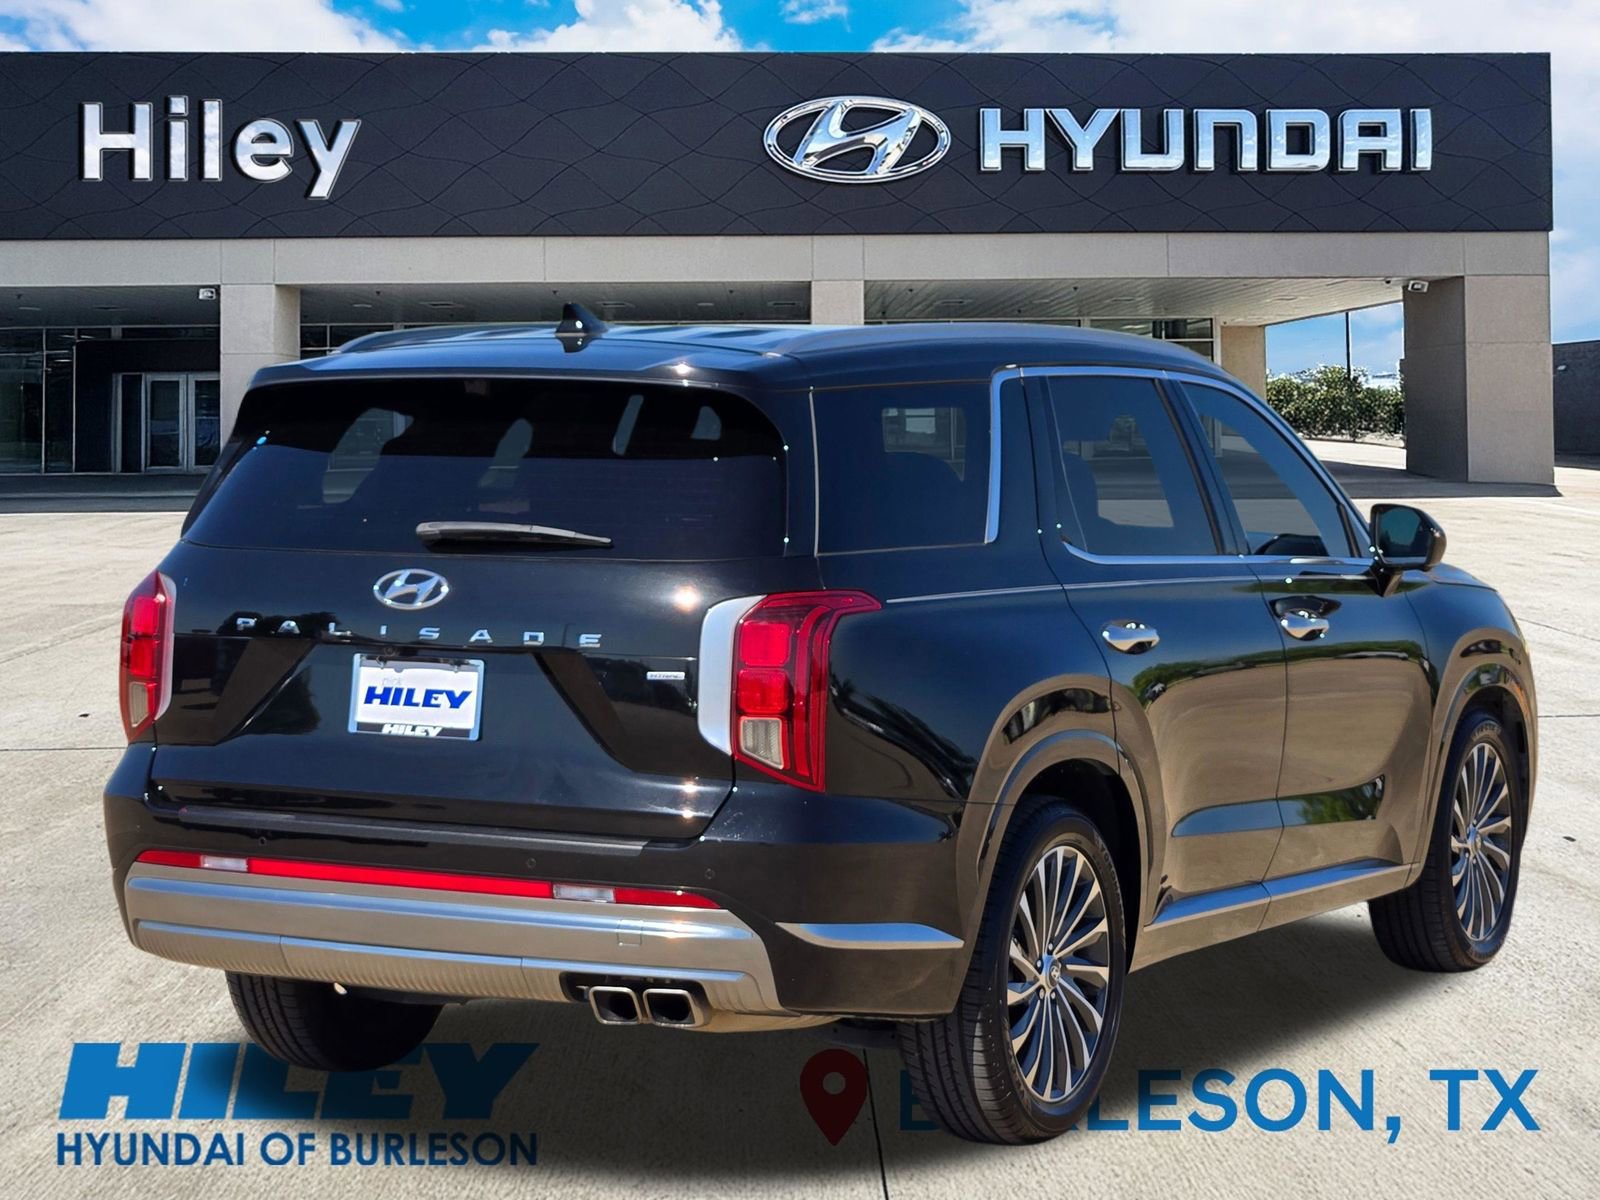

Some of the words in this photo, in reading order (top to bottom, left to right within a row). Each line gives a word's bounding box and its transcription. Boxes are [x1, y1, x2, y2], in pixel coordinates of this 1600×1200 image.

[80, 95, 361, 199] Hiley
[979, 108, 1433, 172] HYUNDAI
[236, 617, 603, 648] PALISADE
[364, 686, 472, 709] HILEY
[381, 723, 443, 737] HILEY
